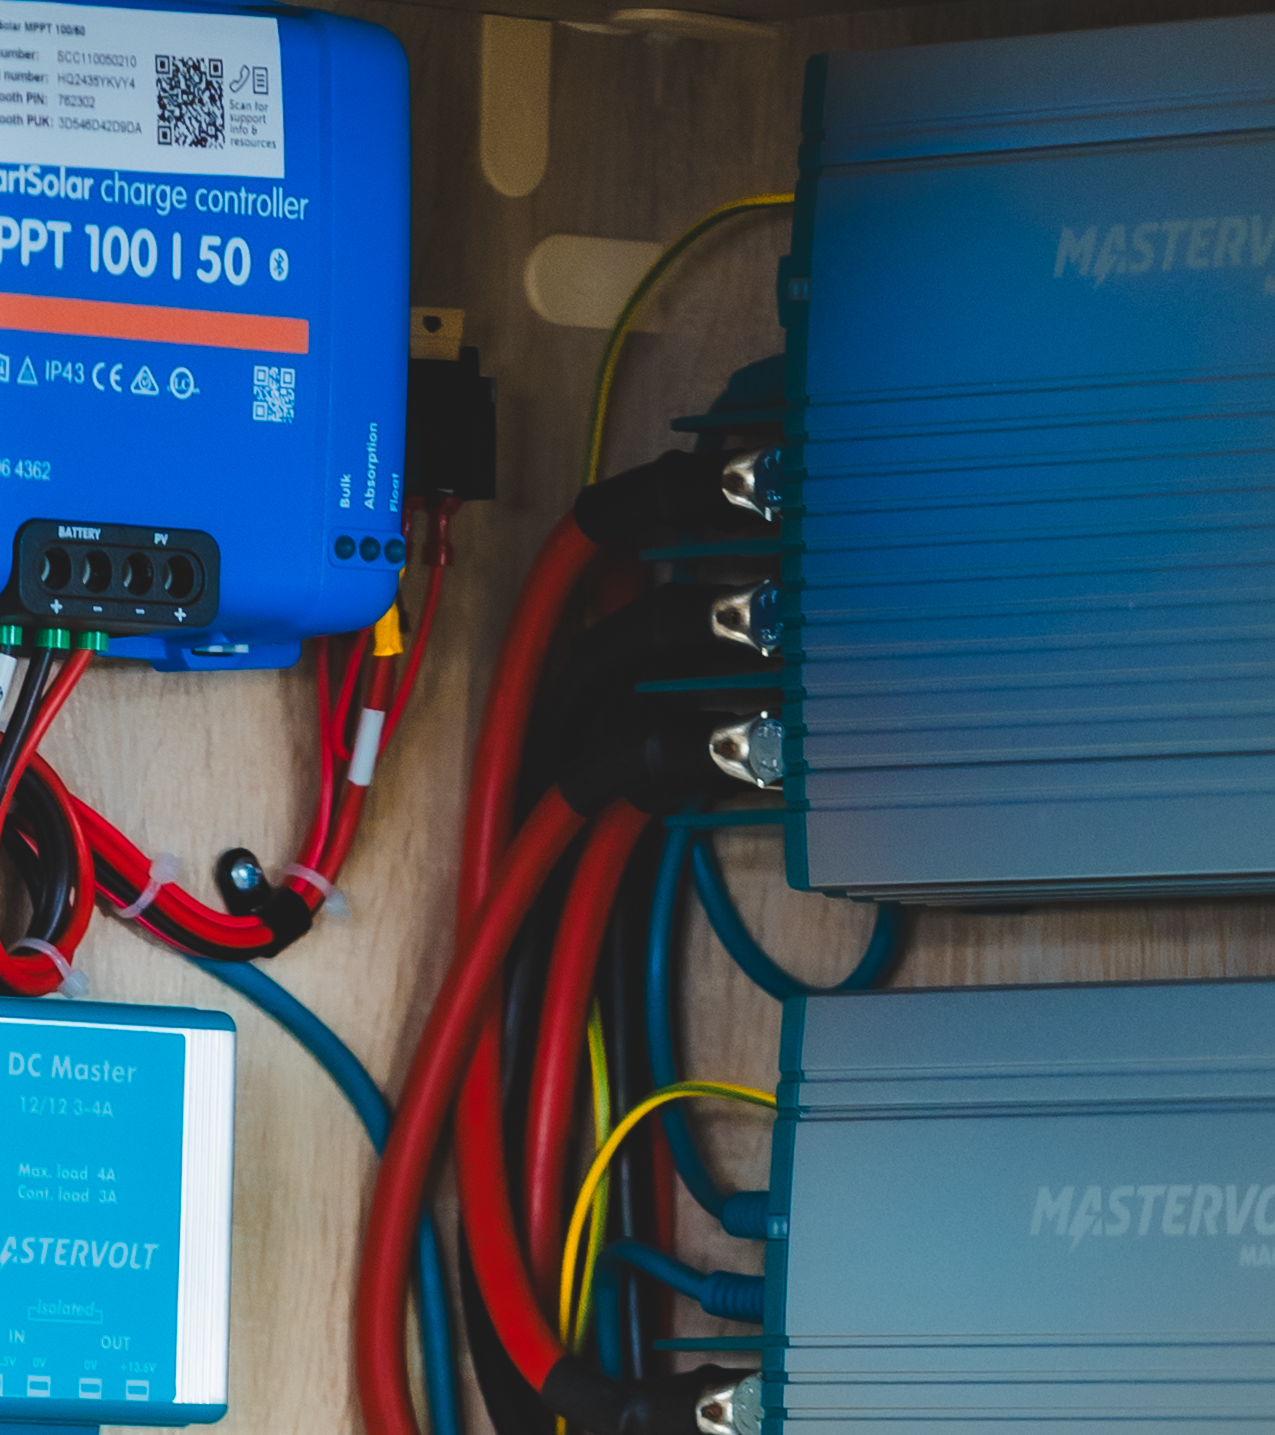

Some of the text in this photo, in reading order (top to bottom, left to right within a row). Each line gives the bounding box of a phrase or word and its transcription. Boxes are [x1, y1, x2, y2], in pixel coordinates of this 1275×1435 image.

[25, 22, 51, 34] MPPT
[4, 69, 49, 84] number:
[229, 99, 269, 112] Scan for
[27, 114, 53, 129] PUK:
[230, 113, 267, 125] support
[230, 138, 277, 149] resources
[100, 172, 187, 217] charge
[195, 187, 309, 221] controller
[84, 223, 158, 278] 100
[196, 235, 251, 286] 50
[45, 359, 85, 385] IP43
[14, 459, 51, 481] 4362
[364, 422, 379, 511] Absorption
[339, 473, 352, 509] Bulk
[389, 472, 400, 513] Float
[58, 525, 168, 546] BATTERY PV
[9, 1052, 136, 1083] DC Master
[20, 1095, 67, 1116] 12/12
[18, 1162, 116, 1182] Max. load 4A
[18, 1184, 117, 1204] Cont. load 3A
[36, 1299, 95, 1316] Isolated
[9, 1329, 131, 1350] IN OUT
